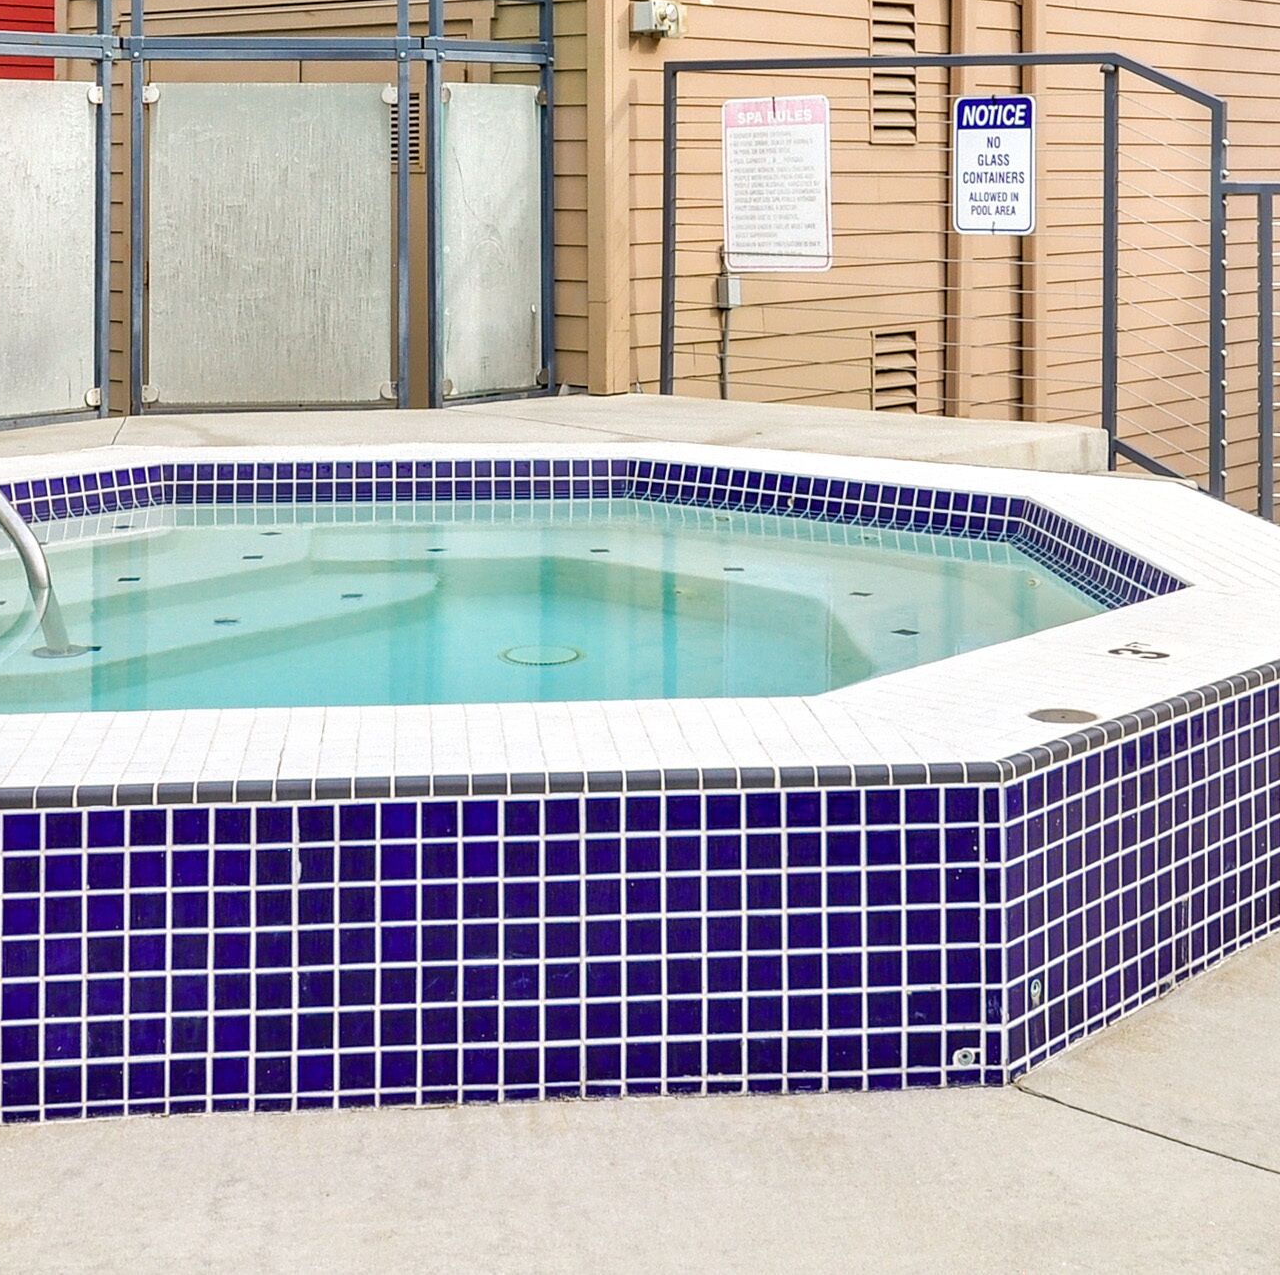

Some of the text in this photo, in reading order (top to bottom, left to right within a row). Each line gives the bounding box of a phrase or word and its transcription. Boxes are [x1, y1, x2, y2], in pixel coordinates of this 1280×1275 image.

[737, 108, 813, 125] SPA RULES
[962, 104, 1027, 127] NOTICE
[986, 136, 1001, 149] NO
[977, 153, 1010, 167] GLASS
[962, 171, 1025, 184] CONTAINERS
[968, 191, 1019, 203] ALLOWED IN
[970, 205, 1017, 216] POOL AREA
